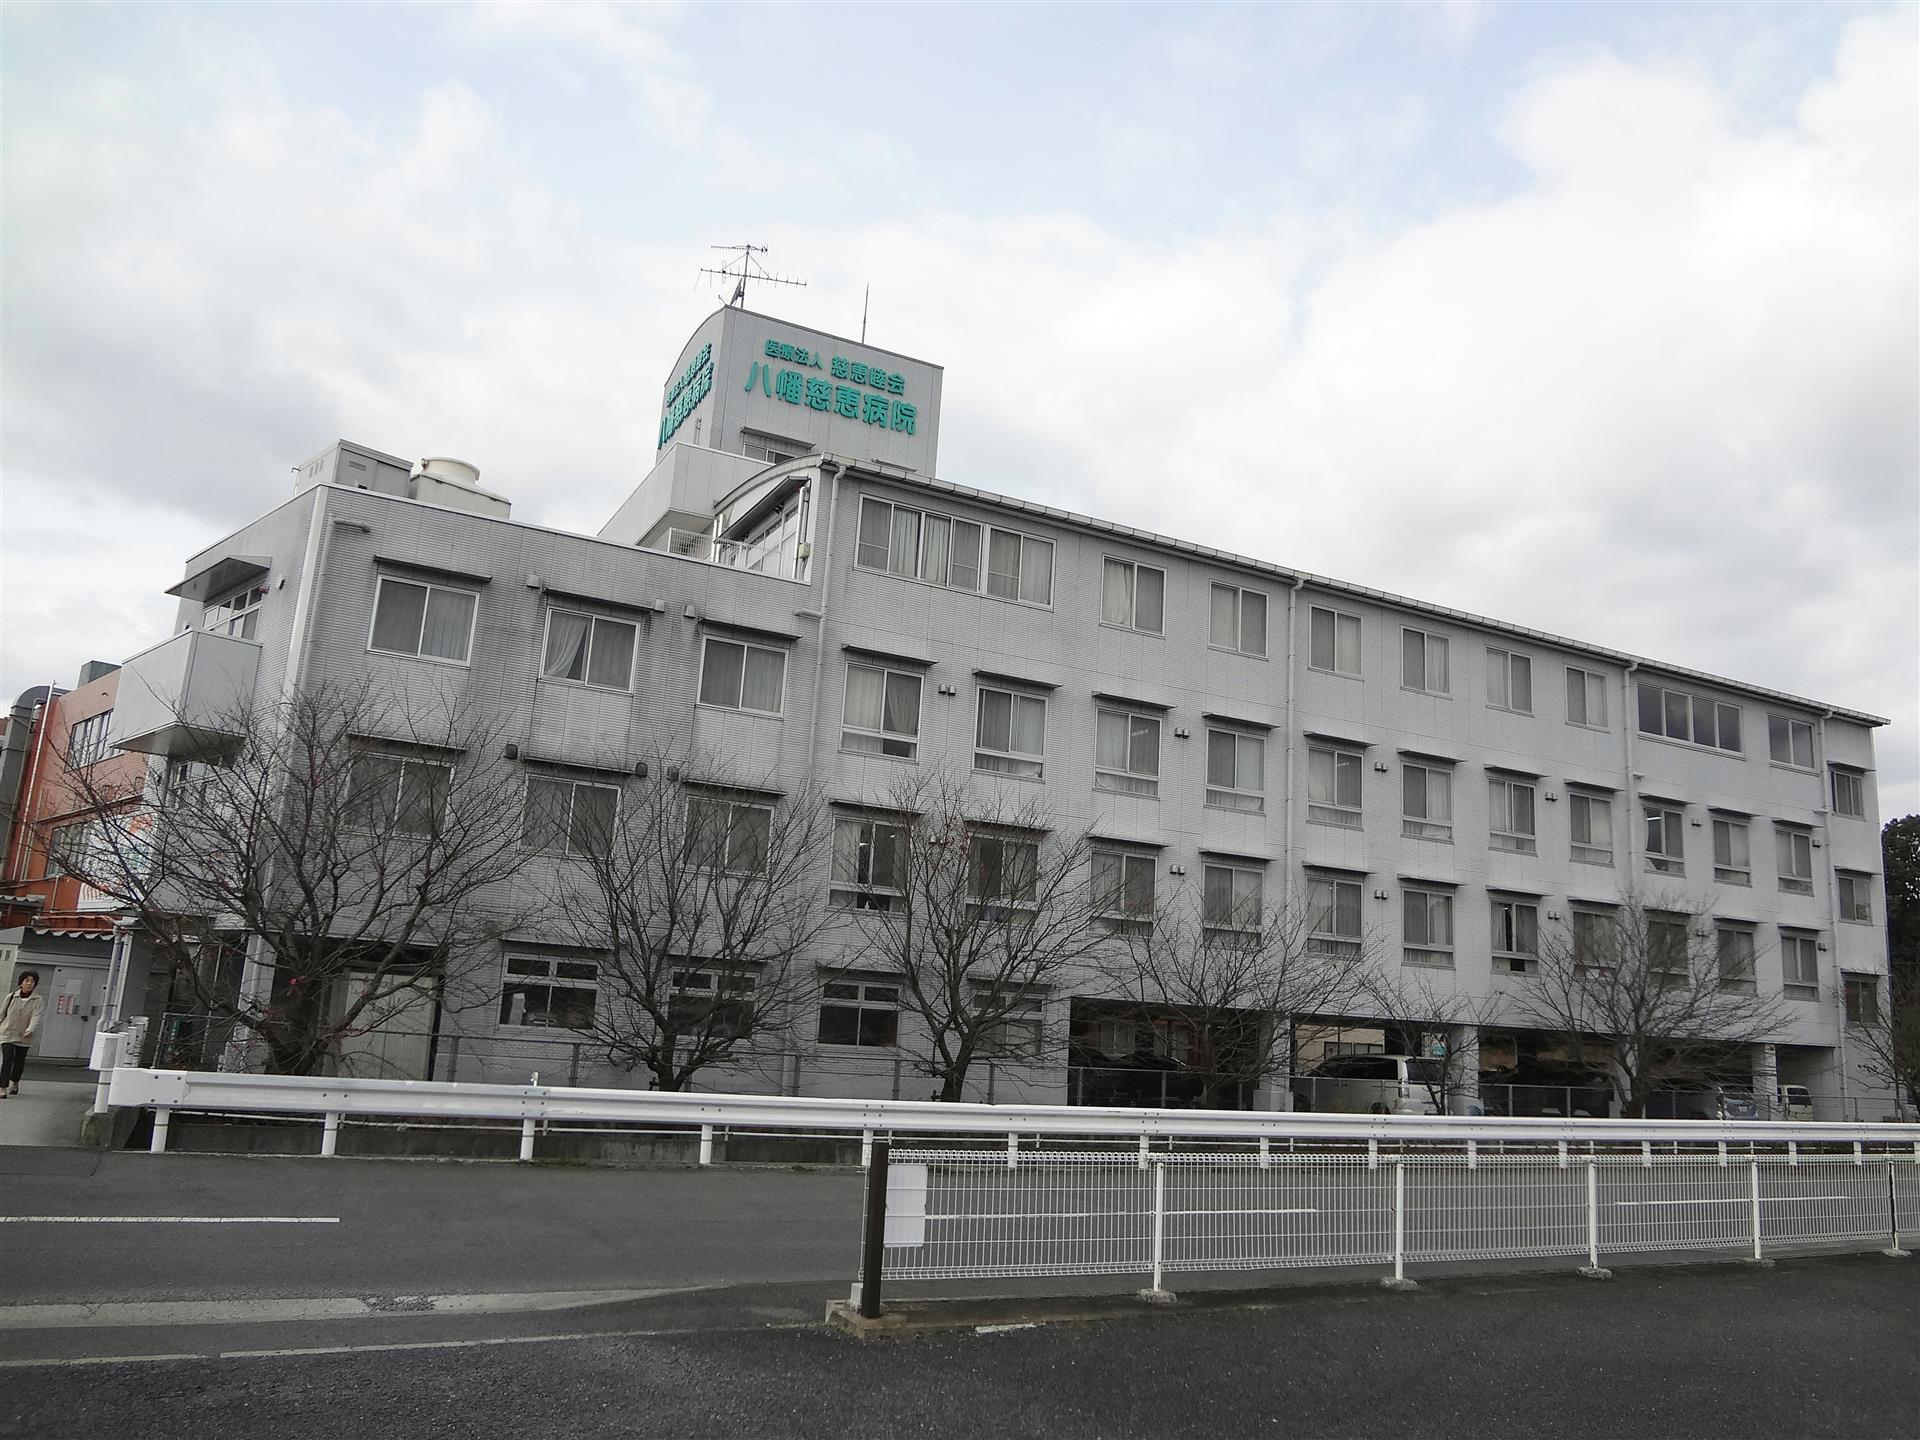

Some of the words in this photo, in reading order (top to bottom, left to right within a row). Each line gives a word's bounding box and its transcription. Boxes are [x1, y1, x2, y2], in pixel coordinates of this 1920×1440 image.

[744, 361, 918, 436] 八幡慈恵病院
[765, 339, 824, 370] 医療法人
[831, 354, 906, 396] 慈恵睦会
